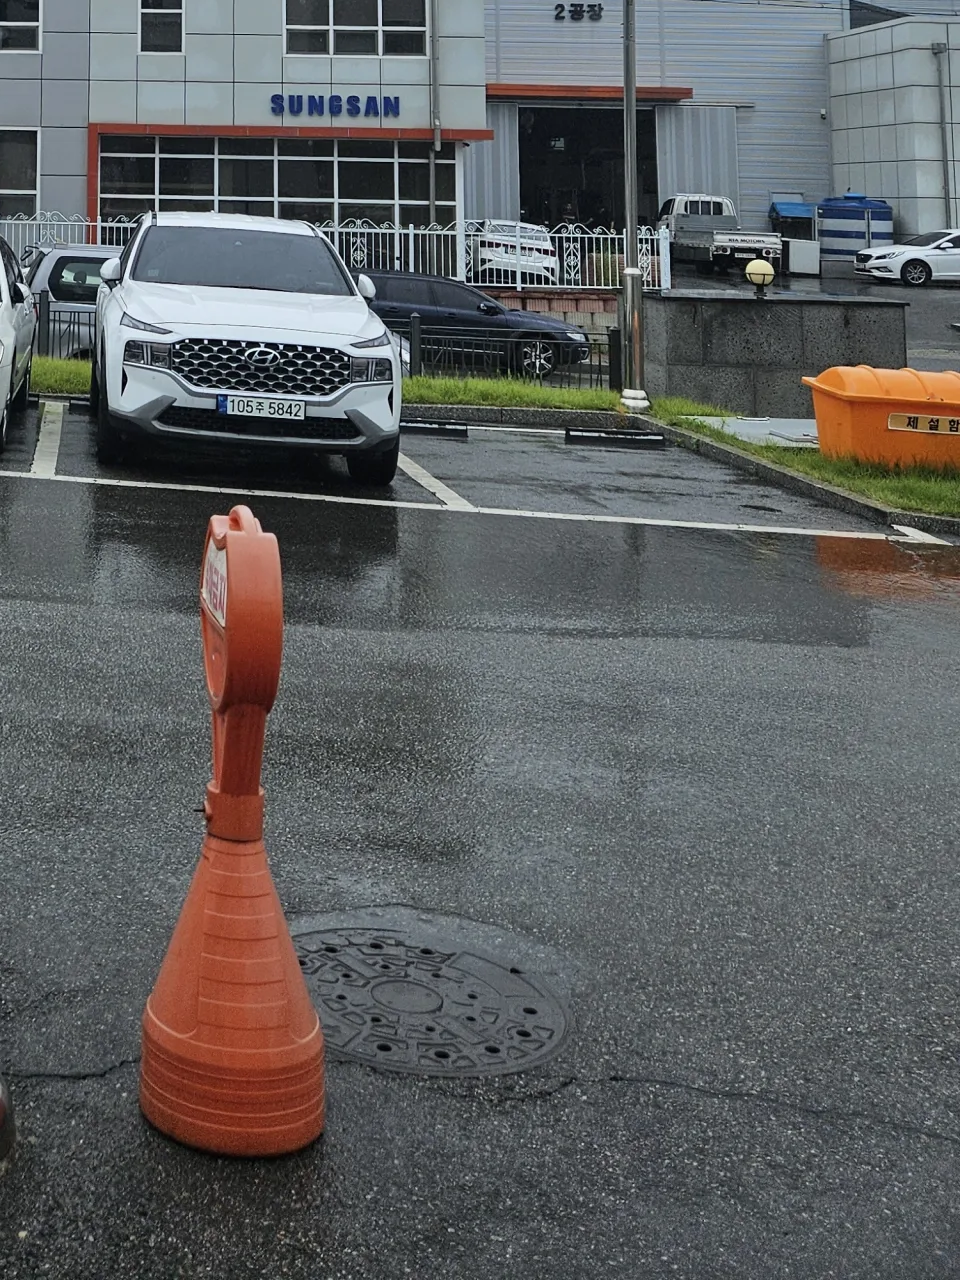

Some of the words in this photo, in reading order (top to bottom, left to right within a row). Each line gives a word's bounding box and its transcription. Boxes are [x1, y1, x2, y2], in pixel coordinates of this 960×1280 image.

[554, 3, 604, 21] 2공장
[270, 94, 400, 117] SUNGSAN
[230, 399, 264, 414] 105주
[268, 402, 302, 417] 5842
